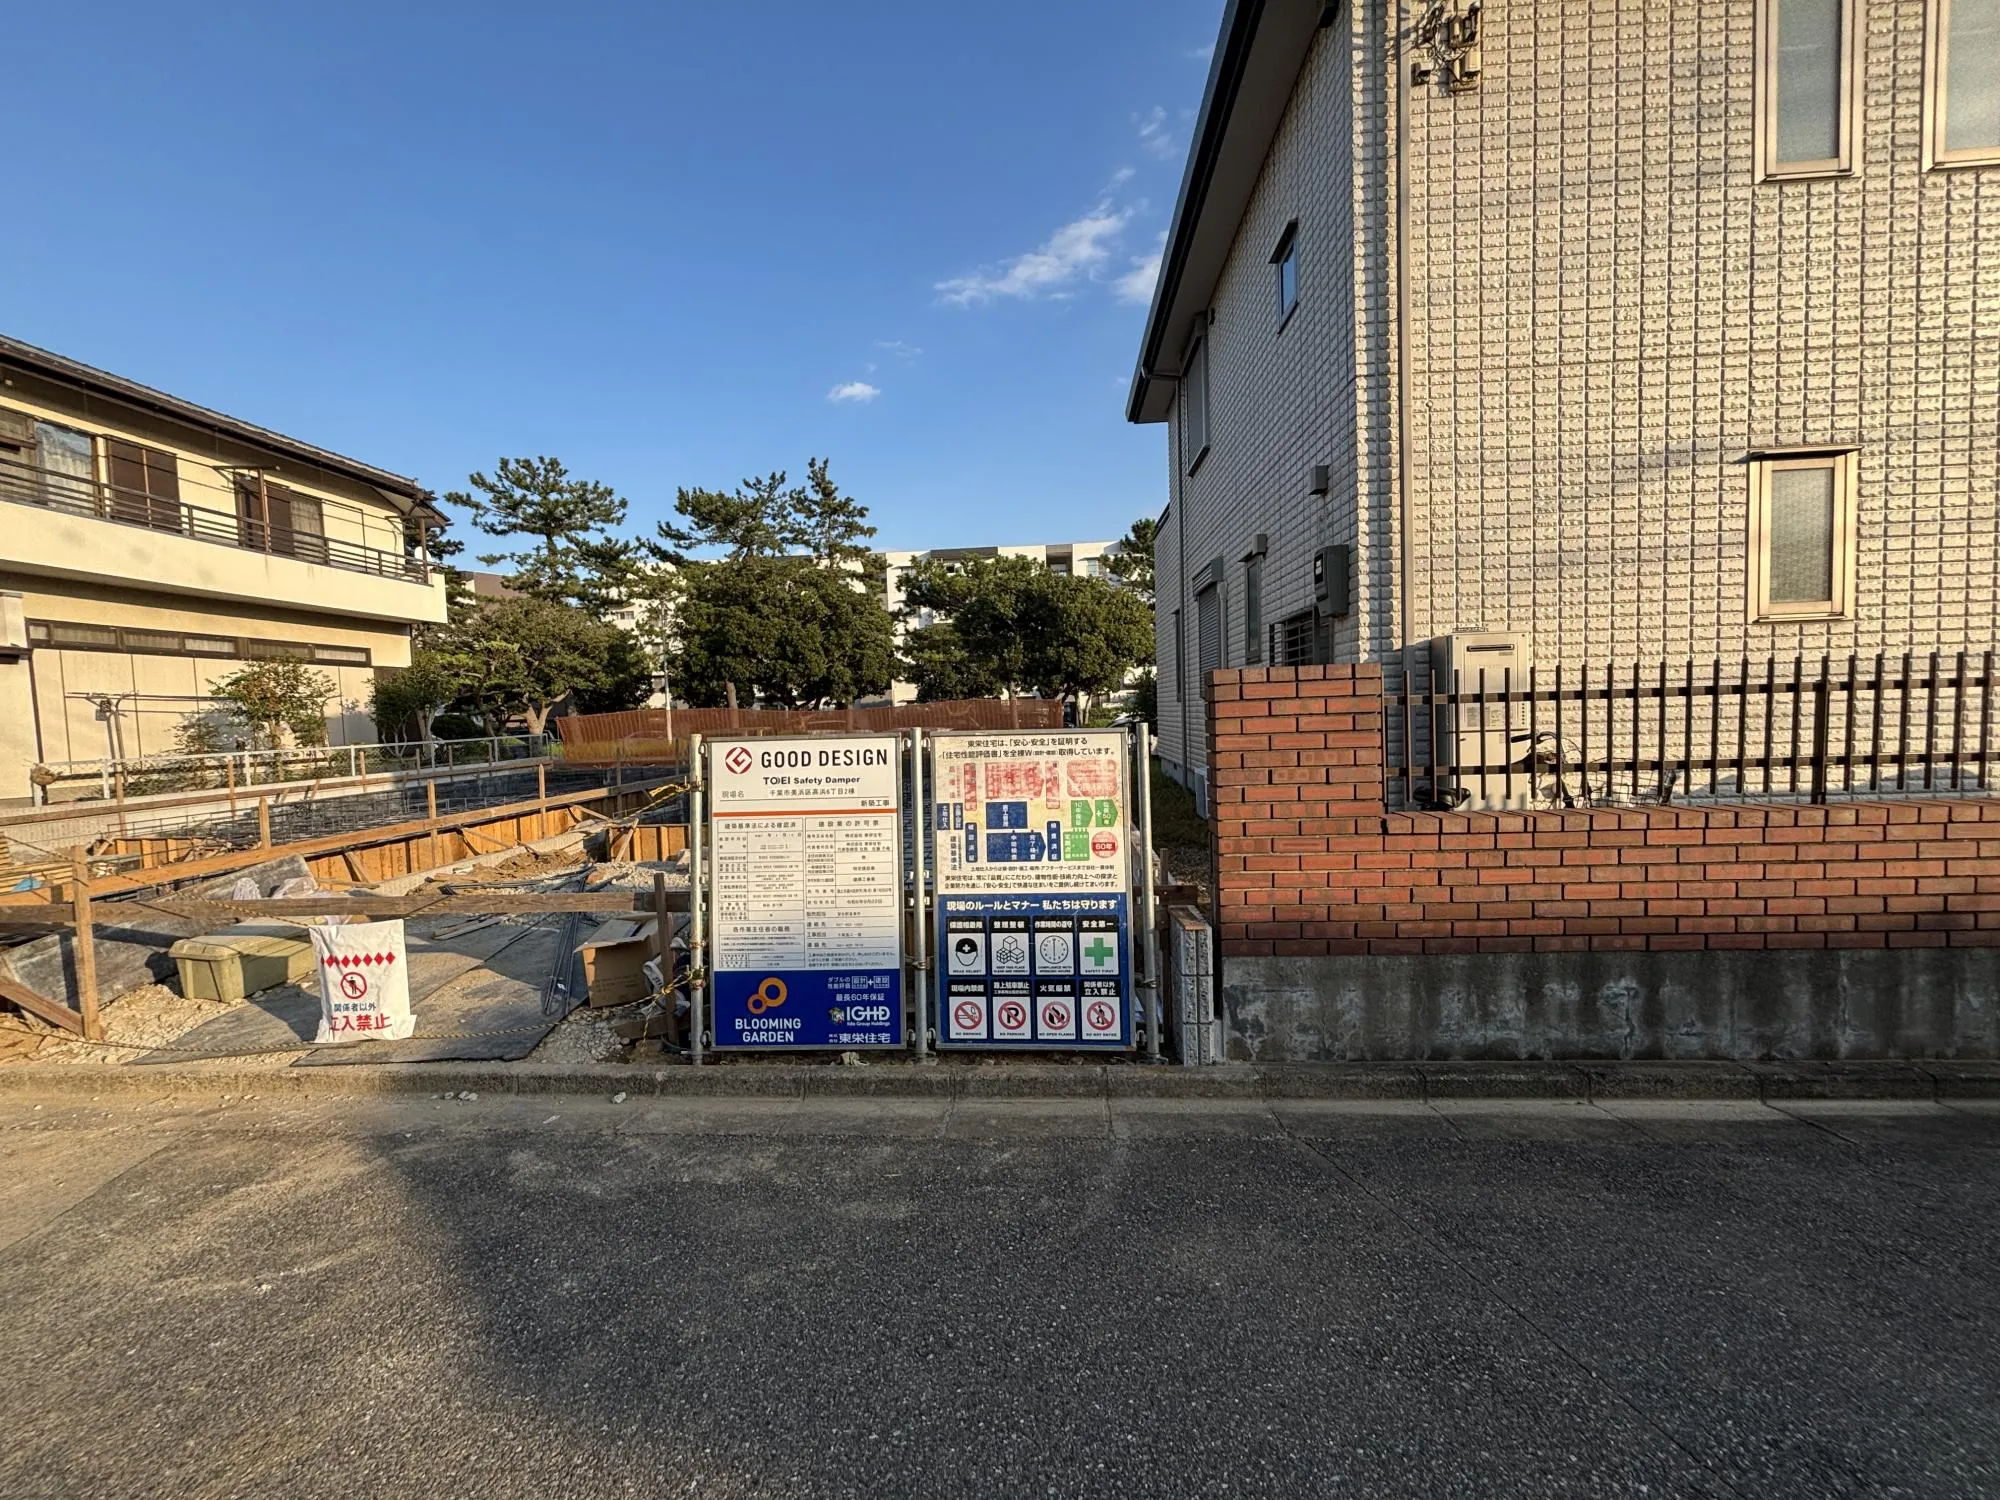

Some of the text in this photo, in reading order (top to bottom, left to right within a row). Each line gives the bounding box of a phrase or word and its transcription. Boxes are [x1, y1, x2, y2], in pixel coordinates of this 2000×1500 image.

[761, 748, 888, 768] GOOD DESIGN
[794, 776, 822, 786] Safety
[825, 776, 860, 785] Damper
[721, 790, 744, 798] 現場名
[946, 899, 1117, 911] 現場のルールとマナー 私たちは守ります
[836, 993, 885, 1001] 最長60年保証
[334, 1002, 376, 1012] 関係者以外
[846, 1006, 890, 1021] IGHD
[735, 1018, 801, 1030] BLOOMING
[742, 1032, 794, 1042] GARDEN
[839, 1033, 890, 1043] 東栄住宅
